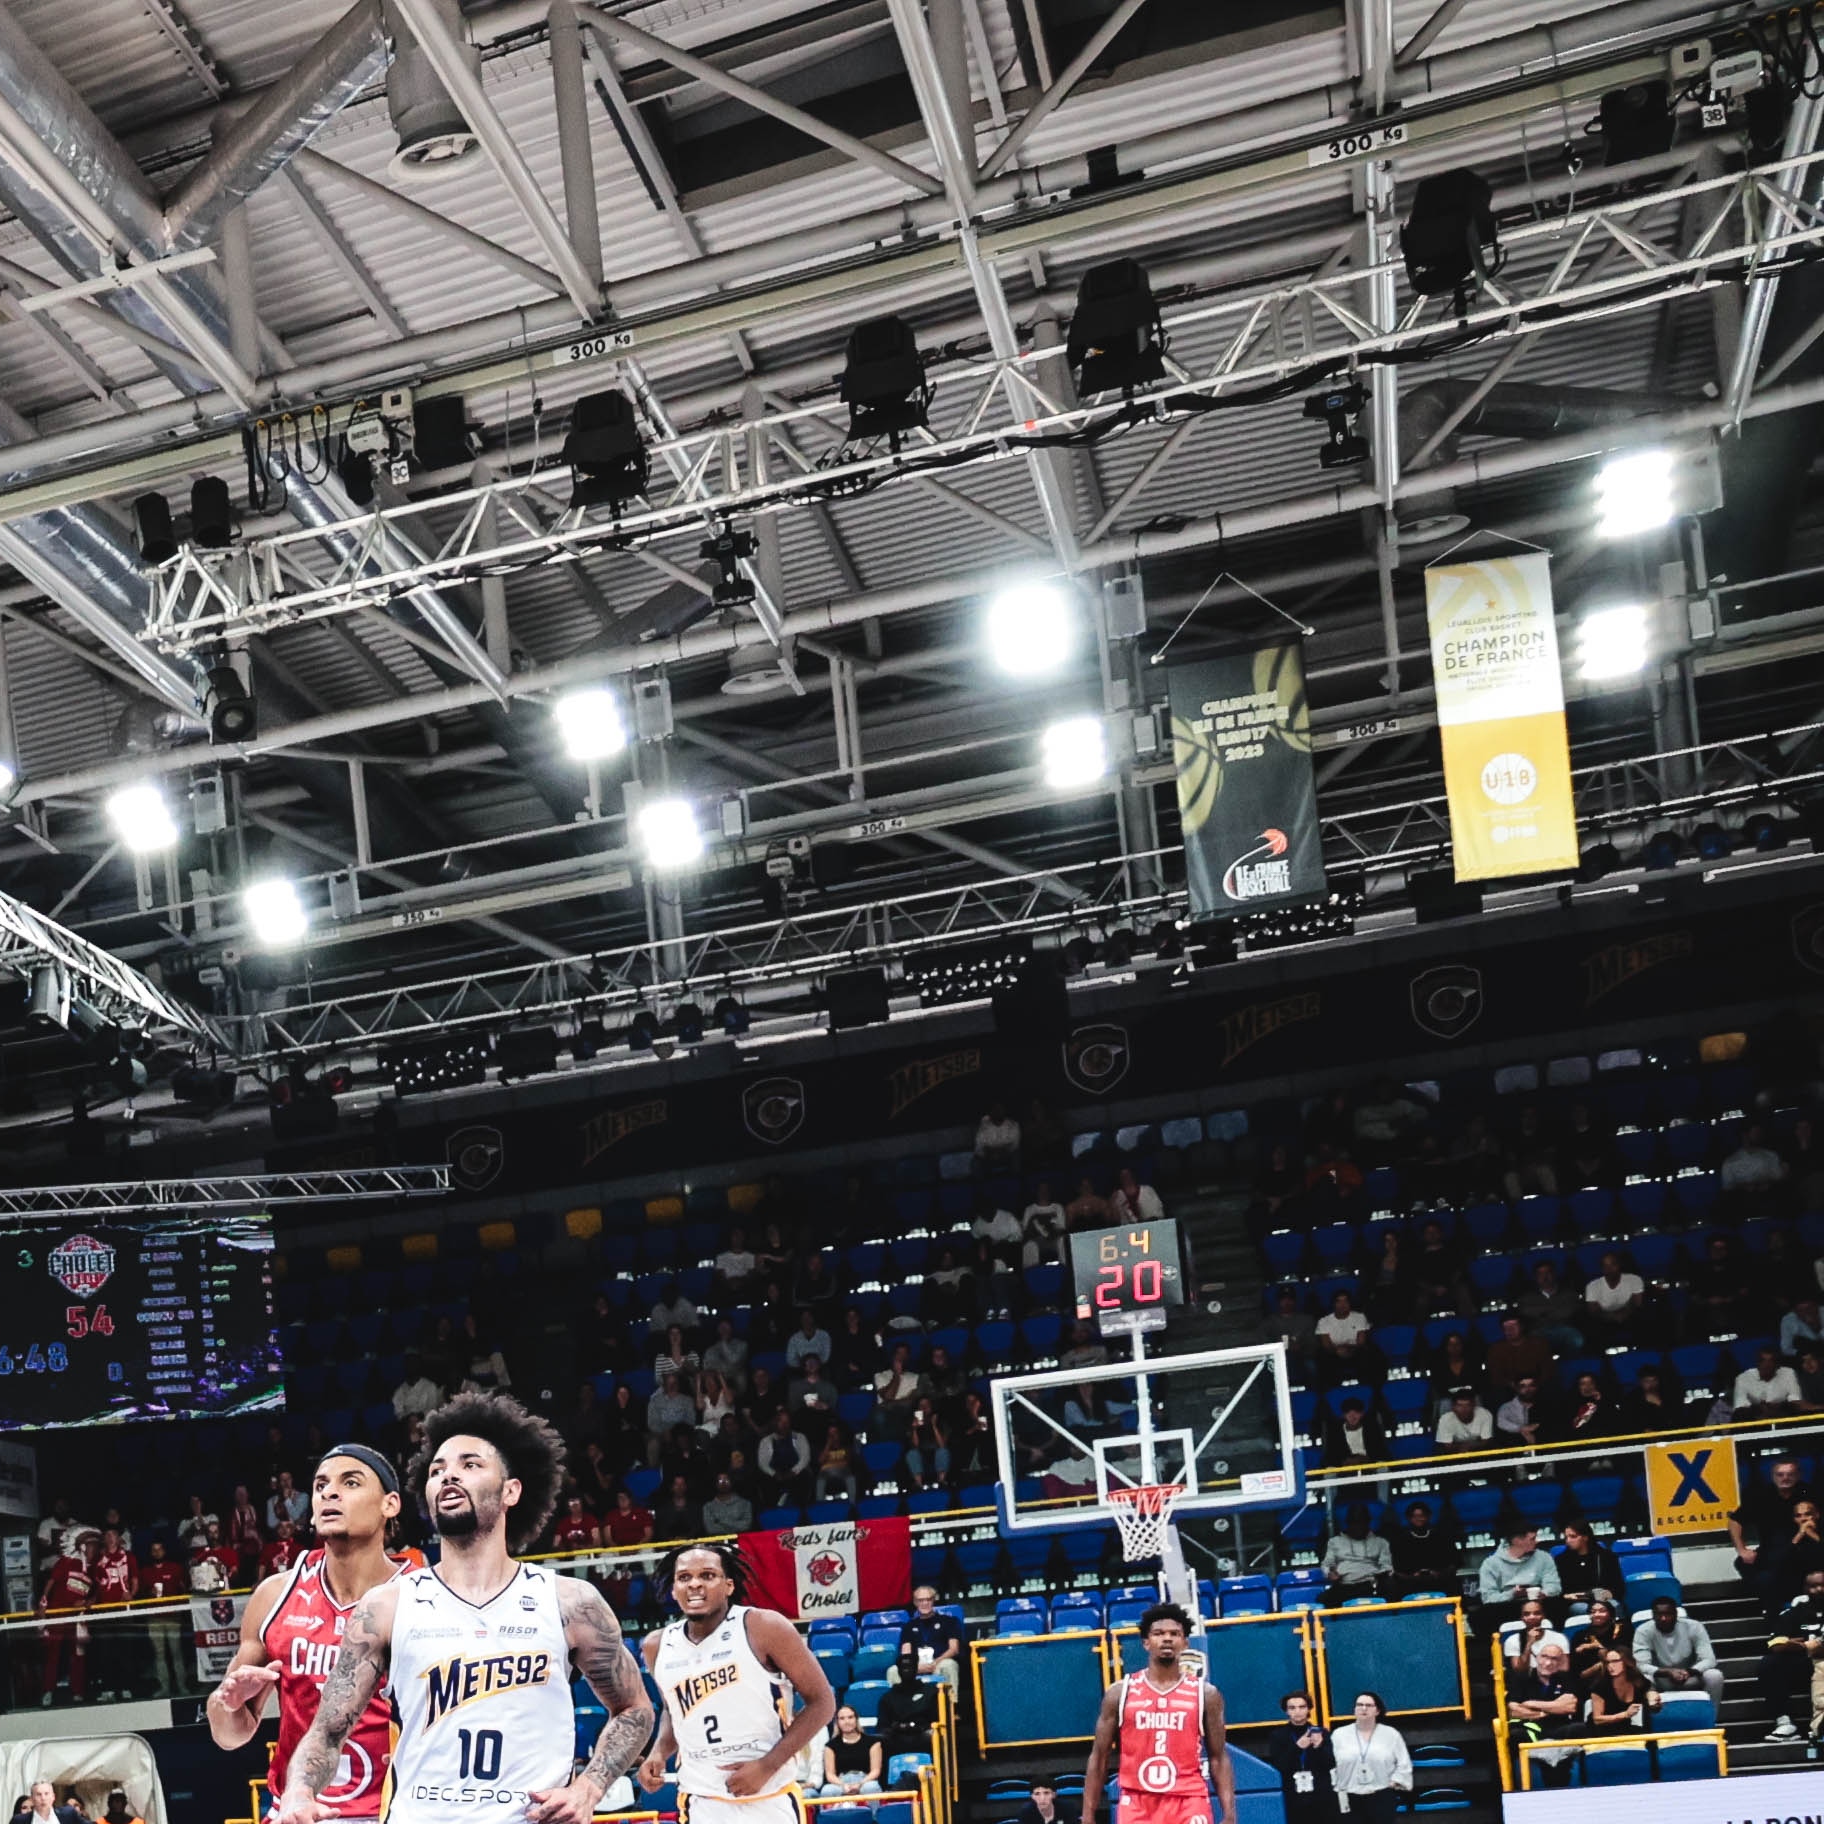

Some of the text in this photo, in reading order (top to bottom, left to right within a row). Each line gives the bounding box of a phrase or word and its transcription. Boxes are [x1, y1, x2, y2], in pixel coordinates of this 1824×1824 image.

[1328, 125, 1403, 160] 300 Kg
[570, 333, 631, 361] 300 Kg
[1444, 630, 1545, 656] CHAMPION
[1445, 645, 1548, 671] DE FRANCE
[1485, 768, 1530, 790] U18
[861, 822, 886, 836] 300
[1099, 1229, 1151, 1263] 6.4
[1095, 1260, 1163, 1308] 20
[66, 1304, 116, 1338] 54
[1667, 1449, 1721, 1508] X
[1656, 1511, 1729, 1526] ESCALIE
[801, 1588, 854, 1610] Cholet
[425, 1653, 549, 1729] METS92
[674, 1664, 737, 1718] METS92
[703, 1714, 722, 1745] 2
[1135, 1710, 1188, 1731] CHOLET
[457, 1728, 504, 1781] 10
[1154, 1730, 1167, 1755] 2
